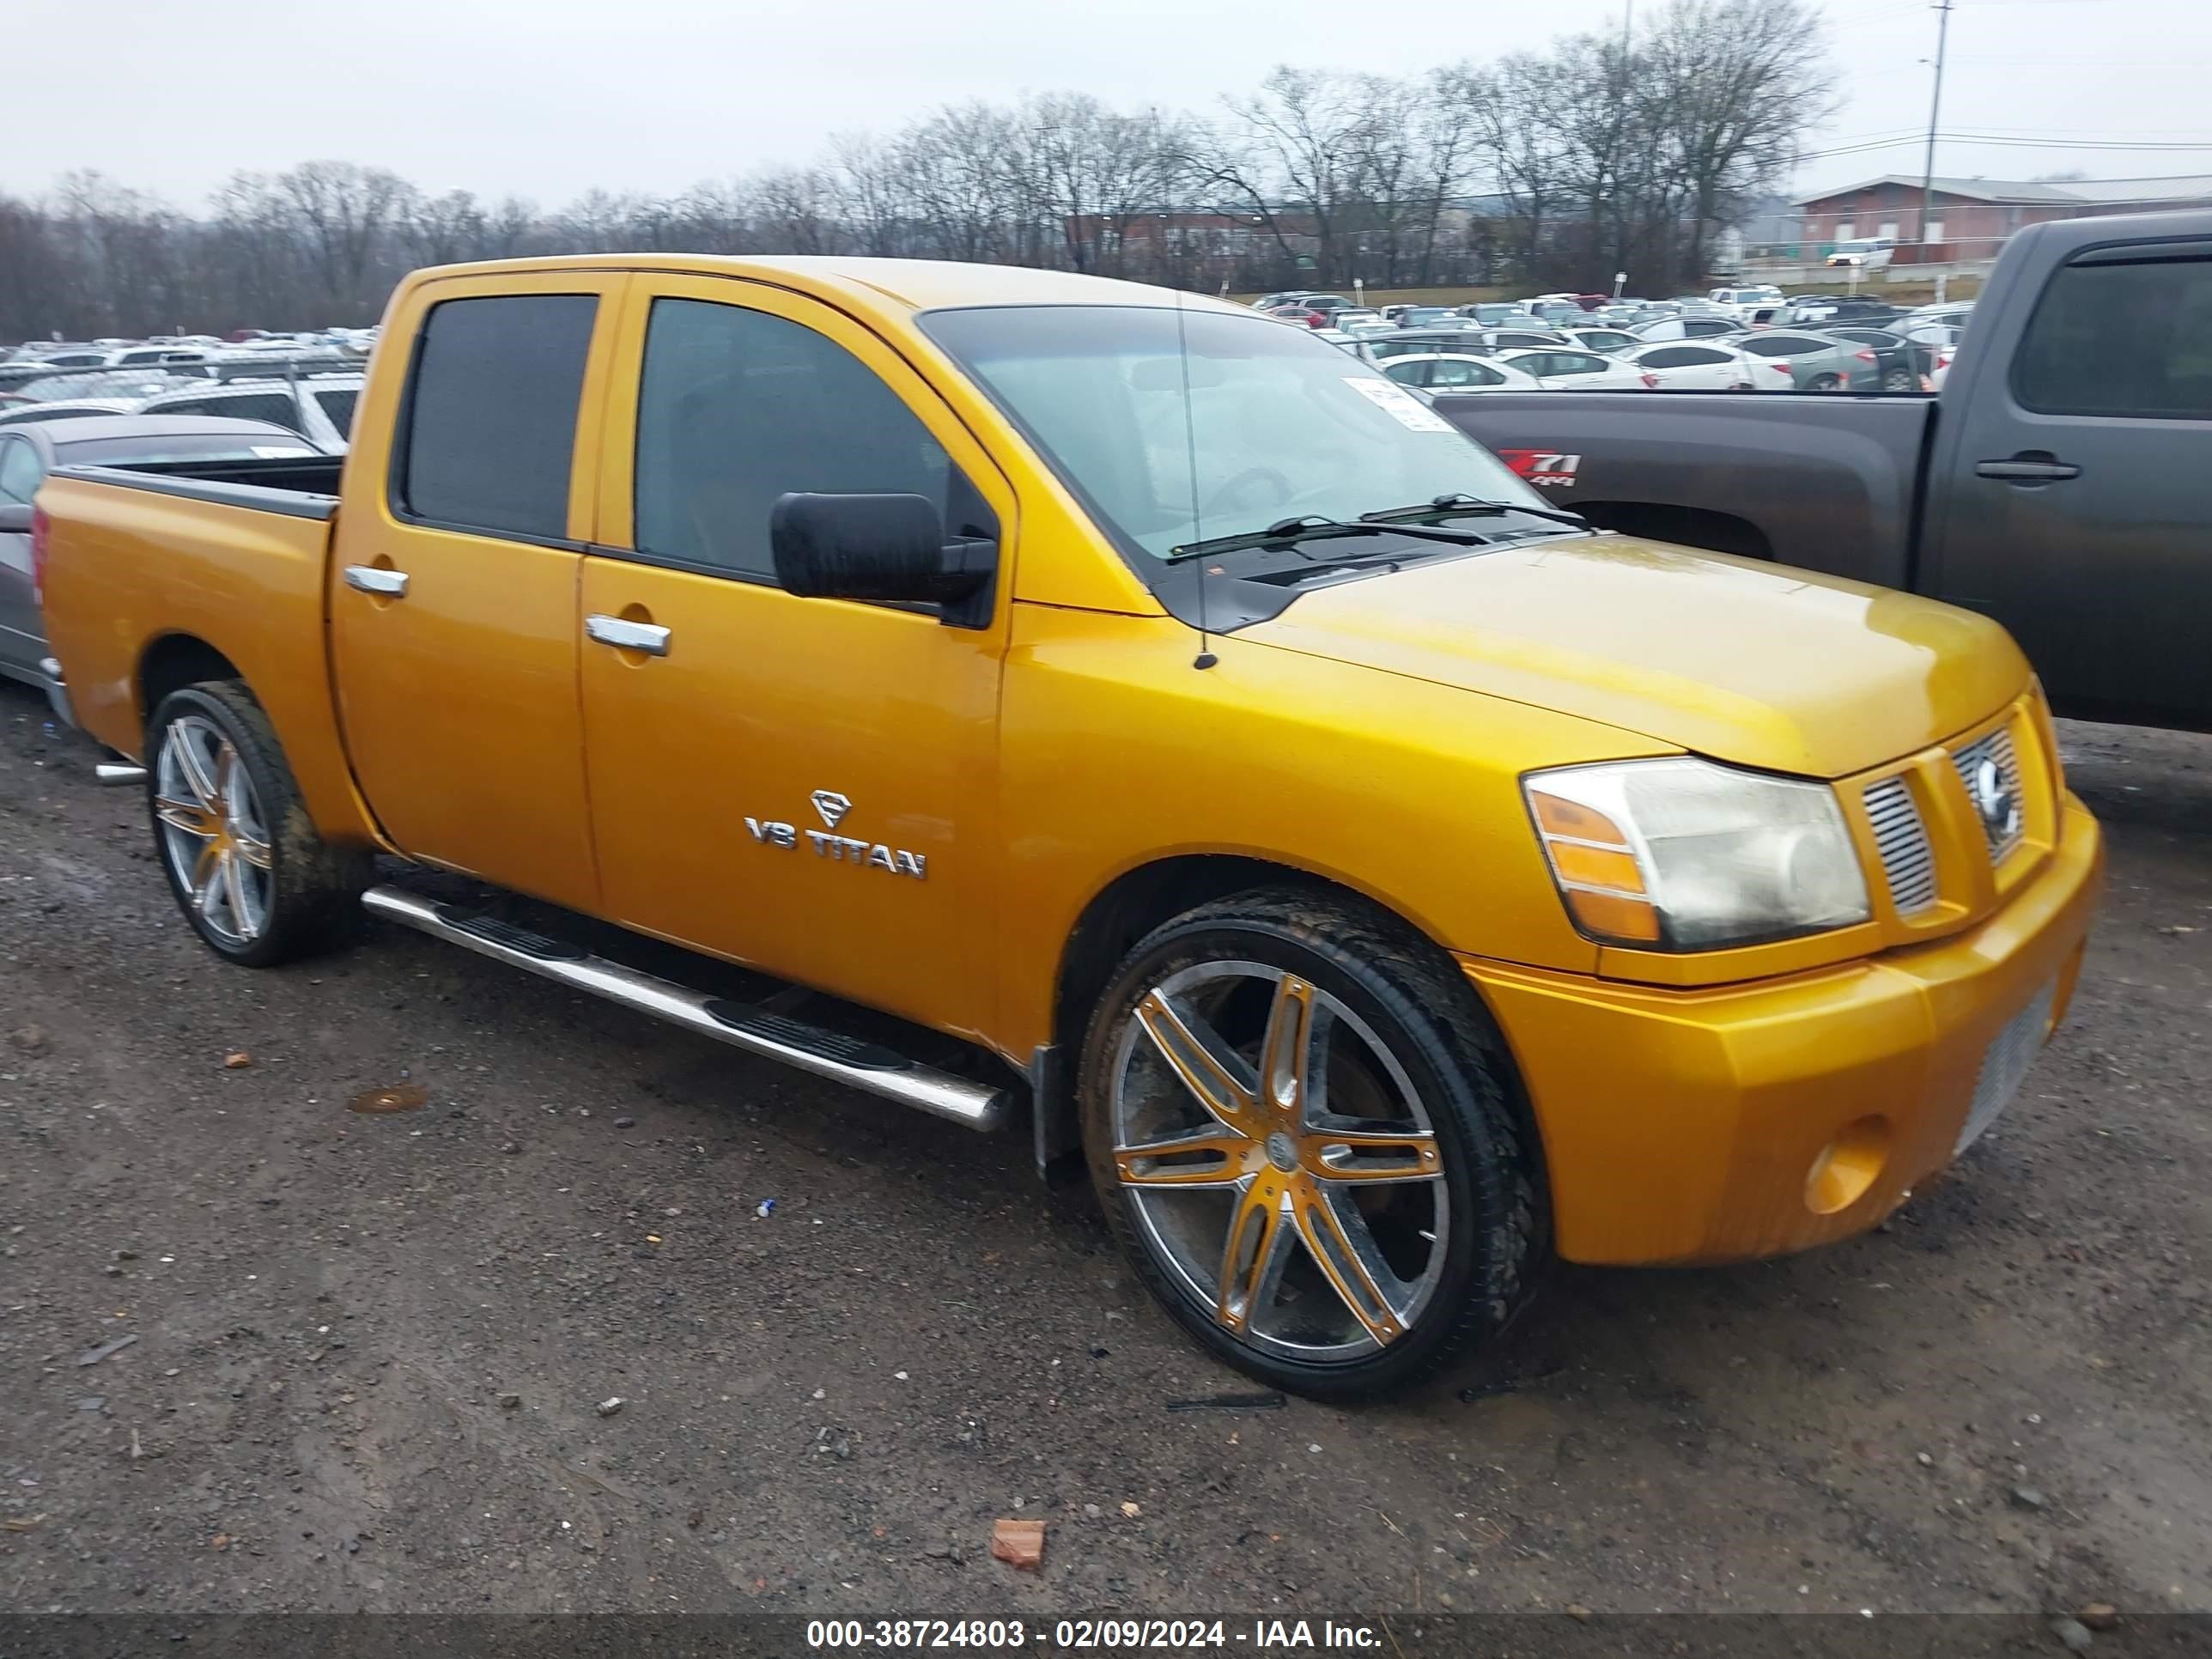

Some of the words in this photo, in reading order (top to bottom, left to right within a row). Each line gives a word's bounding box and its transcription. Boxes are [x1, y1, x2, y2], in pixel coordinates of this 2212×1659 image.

[1497, 449, 1582, 477] Z71
[743, 817, 797, 850] V8
[805, 829, 927, 879] TITAN
